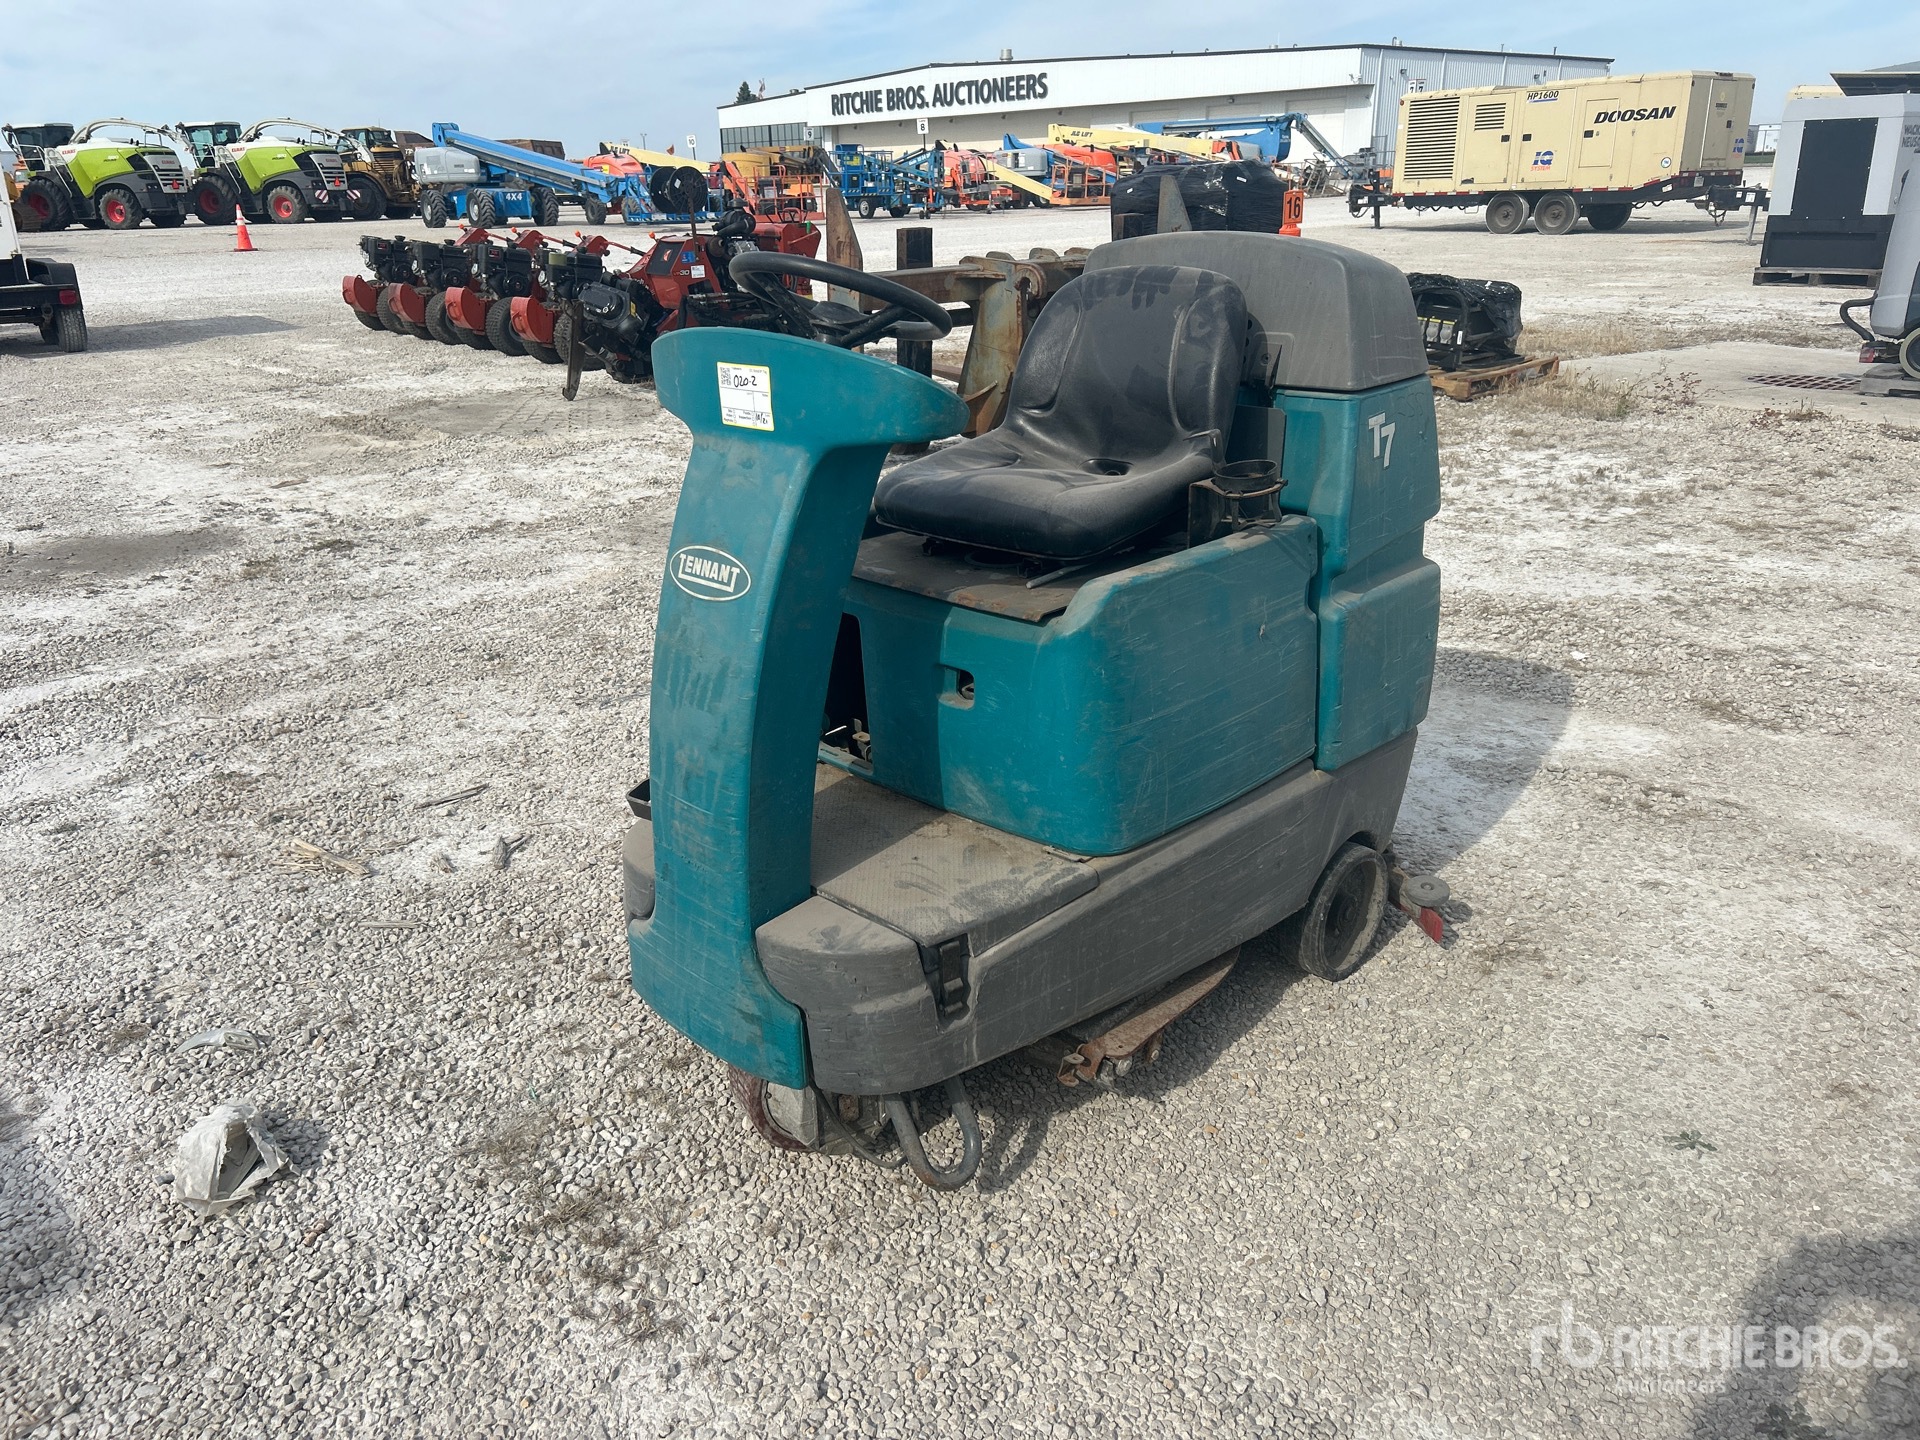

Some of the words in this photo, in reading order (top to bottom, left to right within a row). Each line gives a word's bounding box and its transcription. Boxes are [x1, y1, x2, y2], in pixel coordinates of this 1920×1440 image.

[831, 89, 883, 116] RITCHIE
[886, 85, 929, 112] BROS.
[932, 72, 1049, 108] AUCTIONEERS
[1527, 90, 1560, 100] HP1600
[1593, 105, 1677, 124] DOOSAN
[807, 131, 812, 139] 9
[920, 123, 926, 131] 8
[505, 192, 523, 201] 4X4
[1286, 196, 1301, 220] 16
[733, 374, 758, 388] 020-2
[1368, 412, 1396, 469] T7
[678, 553, 740, 592] TENNANT
